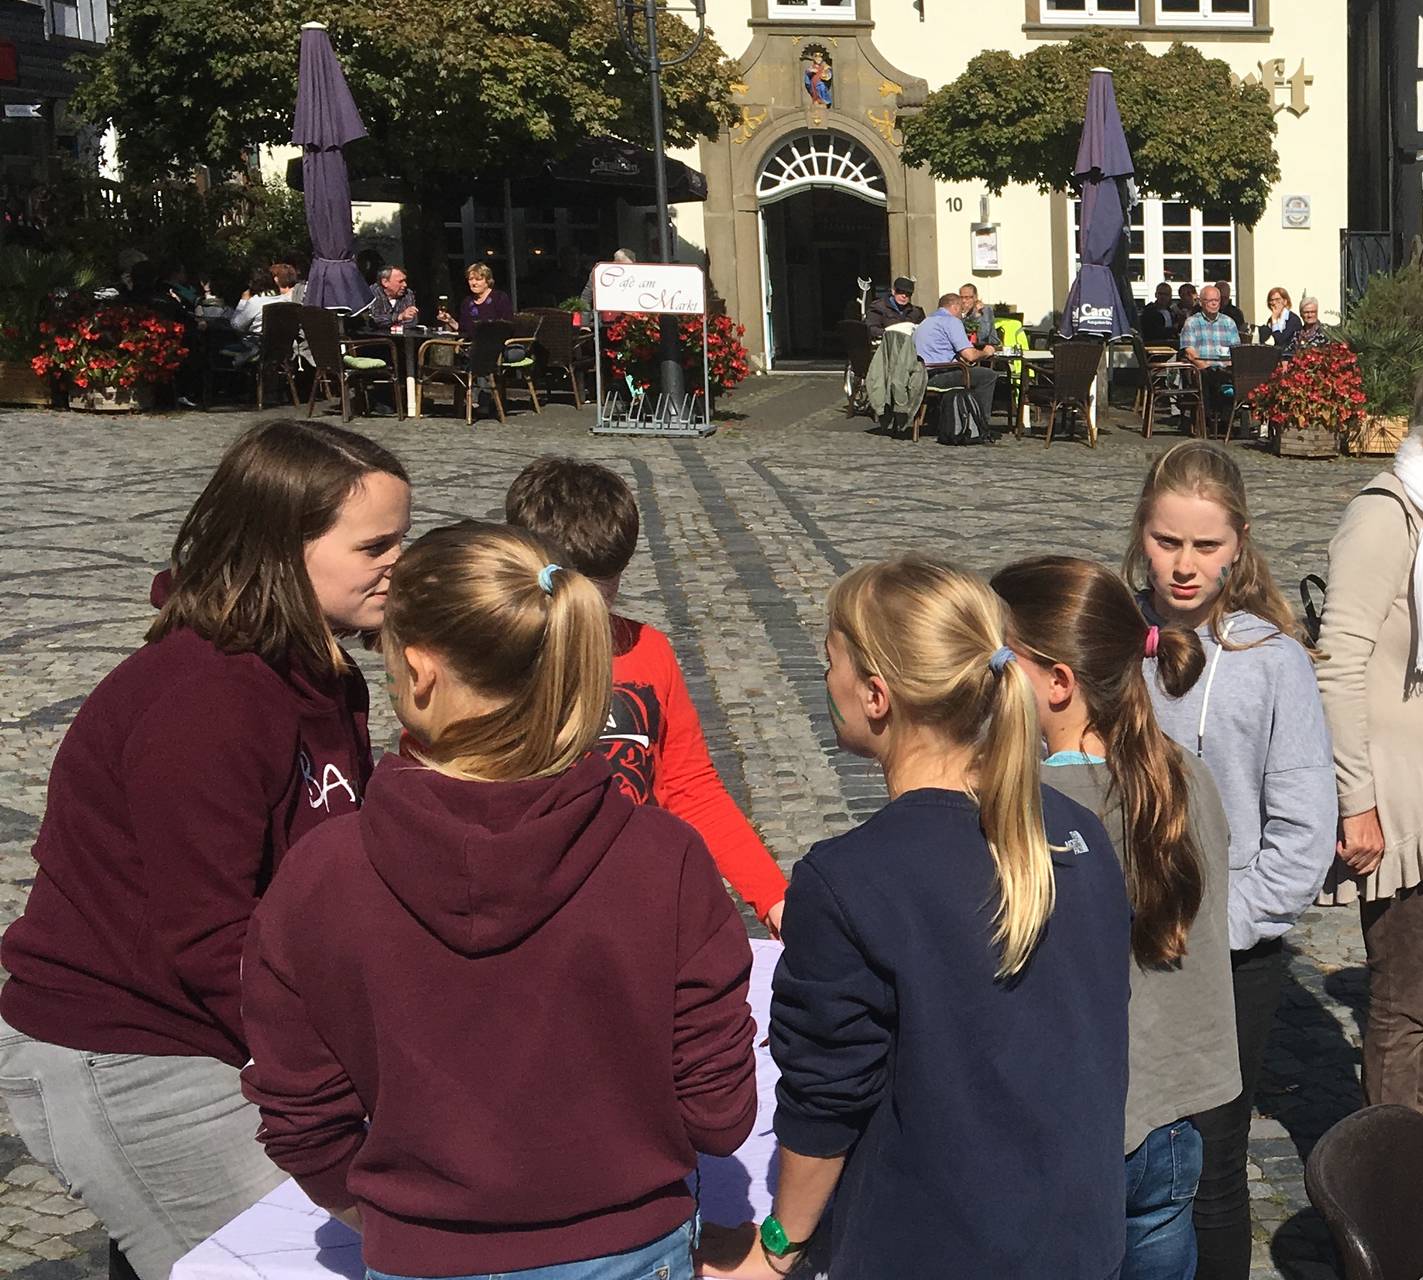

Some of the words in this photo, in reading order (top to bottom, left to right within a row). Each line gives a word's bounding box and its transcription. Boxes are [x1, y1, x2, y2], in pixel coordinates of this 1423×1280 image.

[946, 196, 963, 213] 10
[638, 279, 656, 289] am
[638, 288, 699, 311] Markt
